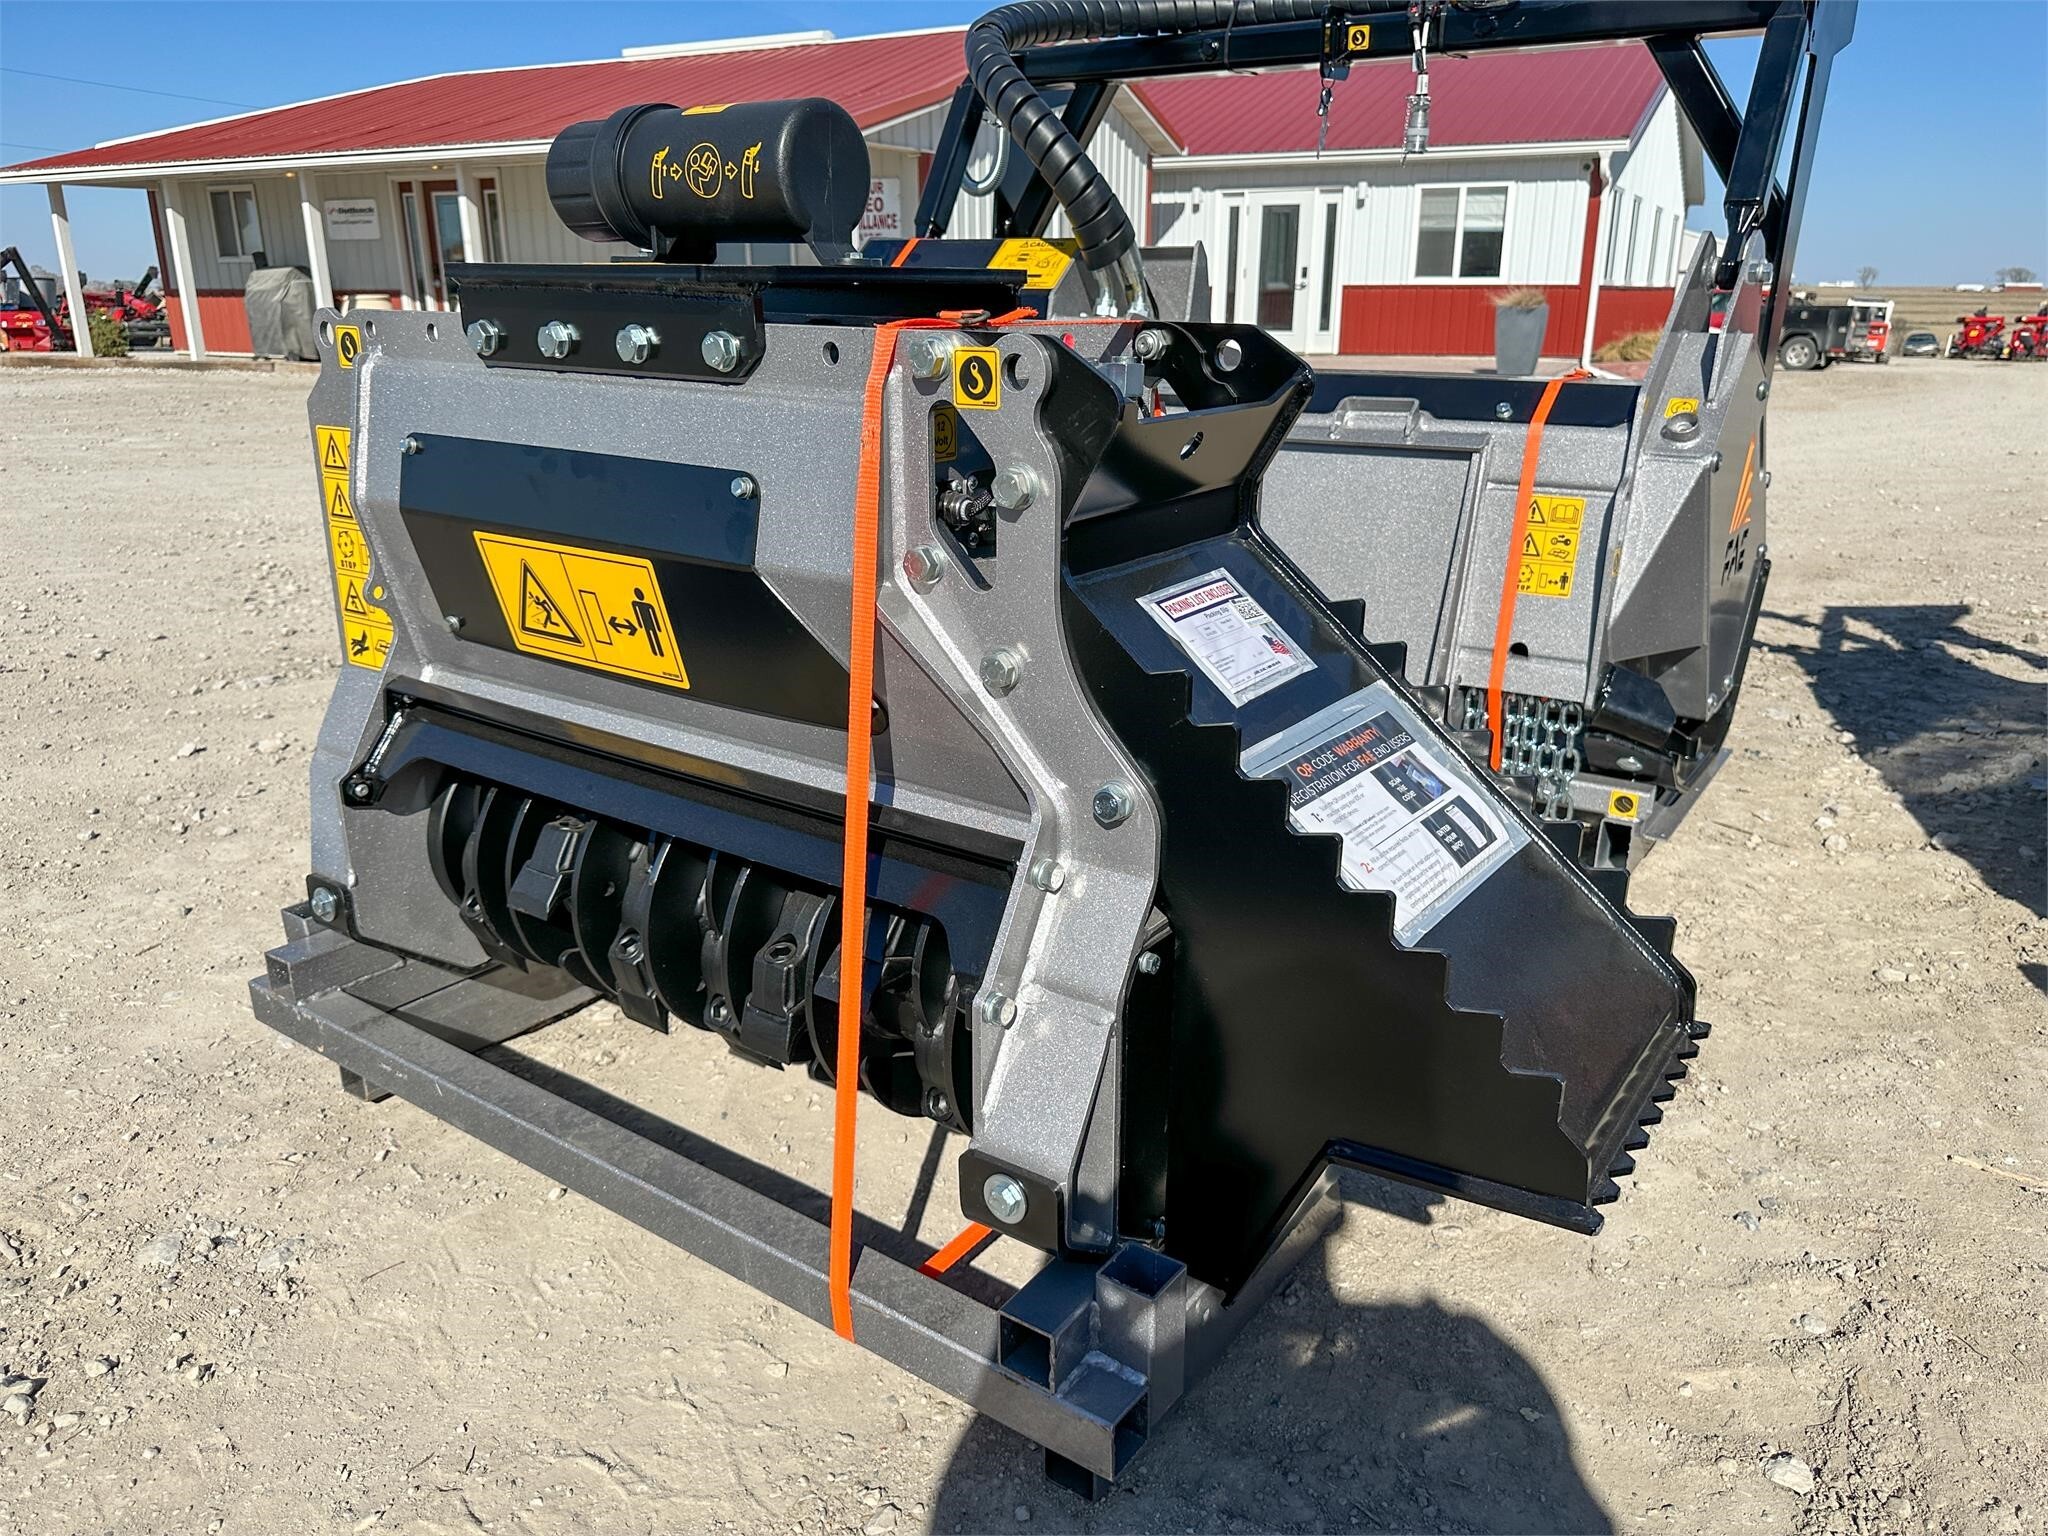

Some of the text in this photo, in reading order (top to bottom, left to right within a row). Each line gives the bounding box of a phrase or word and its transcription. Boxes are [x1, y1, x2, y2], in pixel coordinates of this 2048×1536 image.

[937, 422, 946, 432] 12
[935, 436, 949, 447] Volt
[341, 560, 357, 569] STOP
[1165, 583, 1235, 615] PACKING LIST ENCLOSED
[1203, 611, 1222, 620] Packing
[1296, 727, 1381, 777] QR CODE WARRANTY
[1290, 769, 1346, 806] REGISTRATION
[1344, 759, 1362, 775] FOR
[1356, 750, 1378, 766] FAE
[1372, 743, 1391, 758] END
[1388, 731, 1412, 749] USERS
[1388, 777, 1402, 787] SCAN
[1436, 824, 1452, 838] ENTER
[1444, 832, 1457, 844] YOUR
